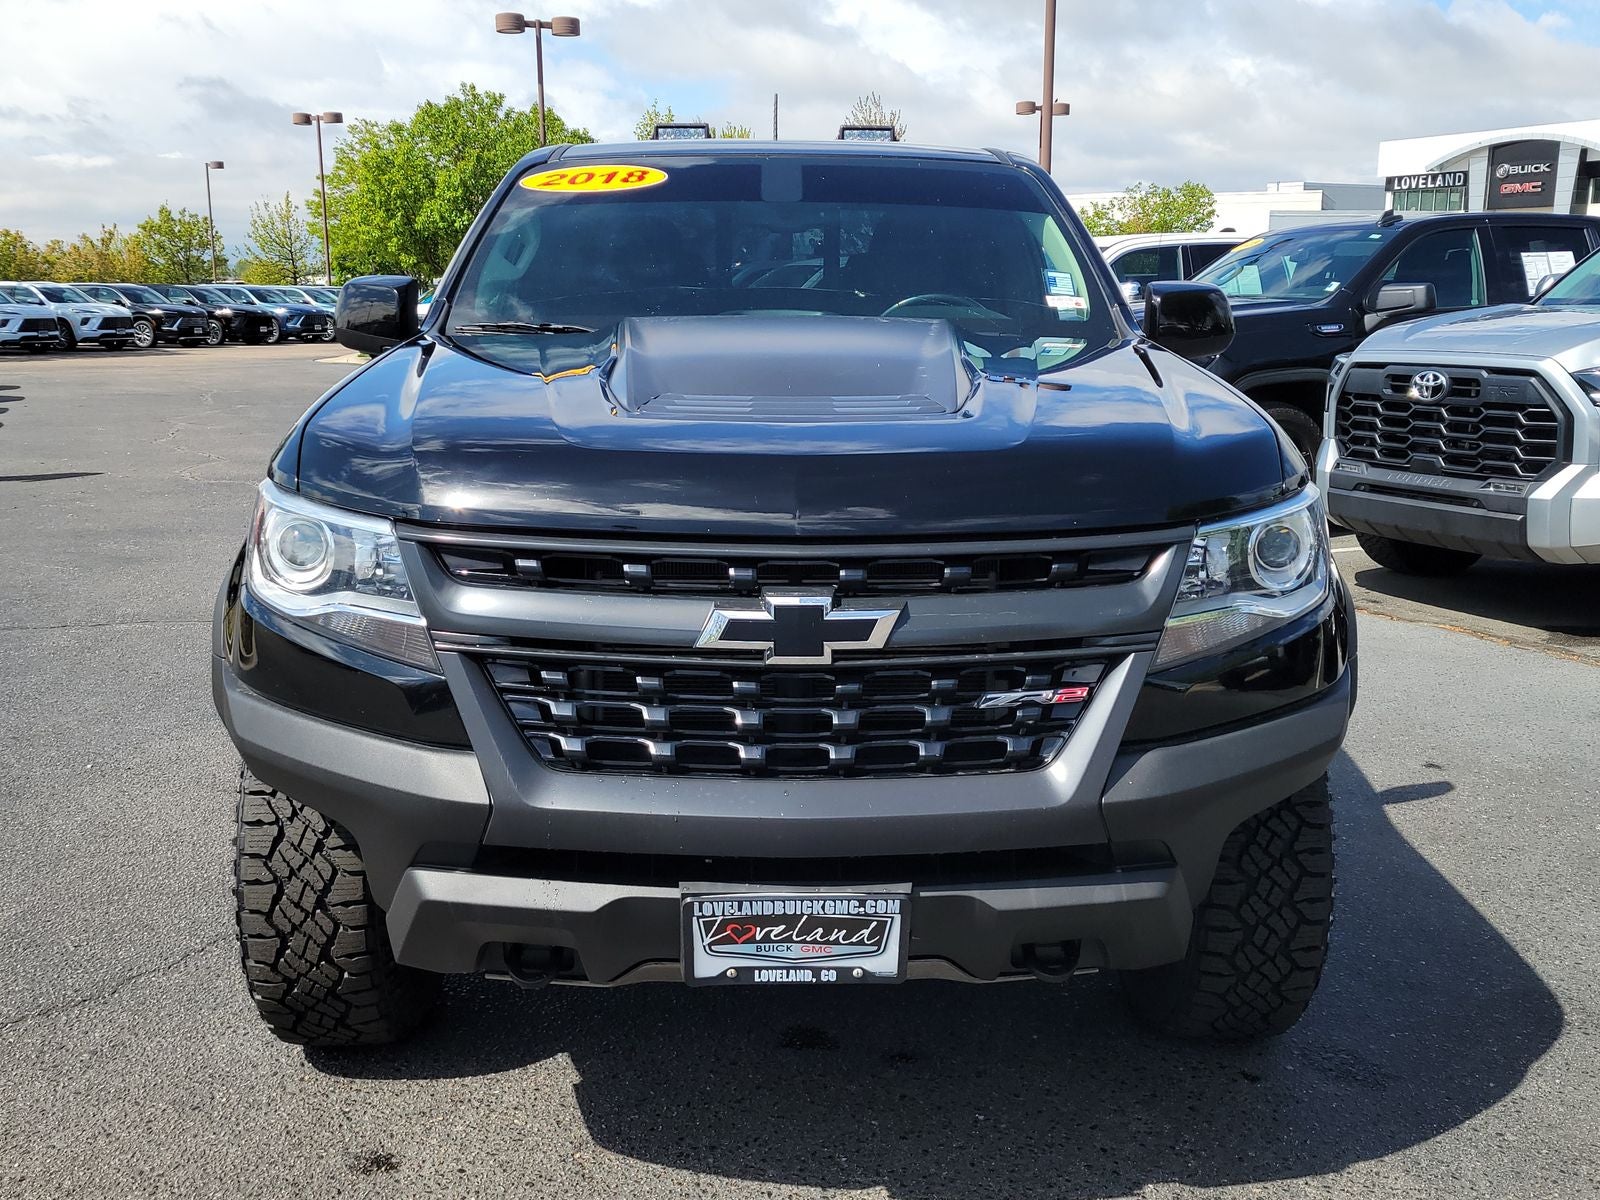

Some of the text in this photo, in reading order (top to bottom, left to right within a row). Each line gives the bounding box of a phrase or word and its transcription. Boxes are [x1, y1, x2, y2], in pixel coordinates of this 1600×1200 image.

[1509, 163, 1551, 175] BUICK
[537, 170, 650, 187] 2018
[1394, 172, 1465, 190] LOVELAND
[1500, 181, 1542, 194] GMC
[693, 899, 900, 916] LOVELANDBUICKGMC.COM
[755, 944, 833, 954] BUICK GMC
[754, 969, 837, 983] LOVELAND, CO
